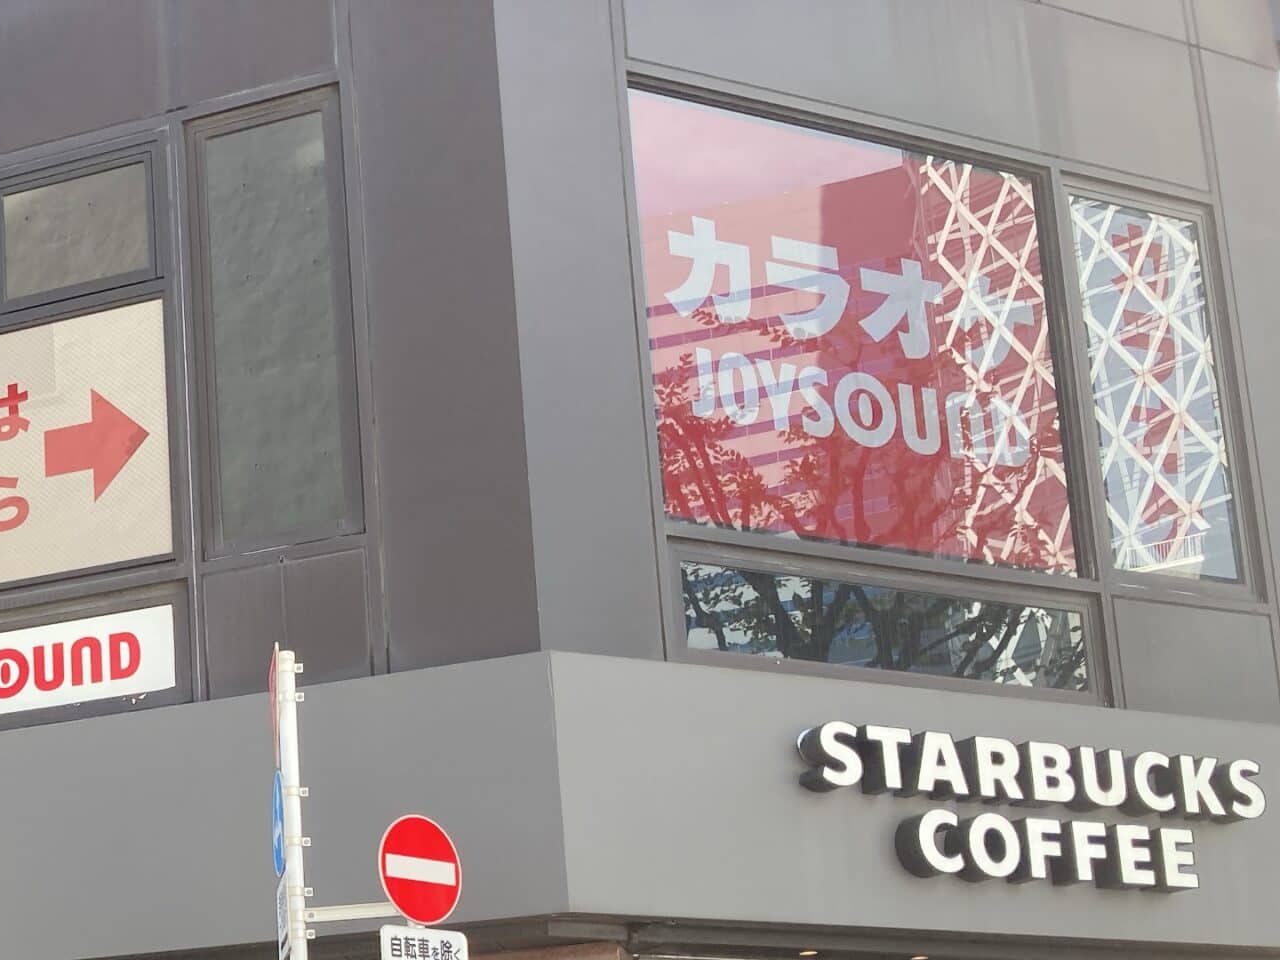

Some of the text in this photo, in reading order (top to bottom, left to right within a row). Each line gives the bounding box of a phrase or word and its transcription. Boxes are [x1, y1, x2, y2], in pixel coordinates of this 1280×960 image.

[663, 215, 1036, 370] カラオケ
[692, 347, 1033, 468] JOYSOUND
[819, 720, 1267, 820] STARBUCKS
[918, 808, 1200, 890] COFFEE
